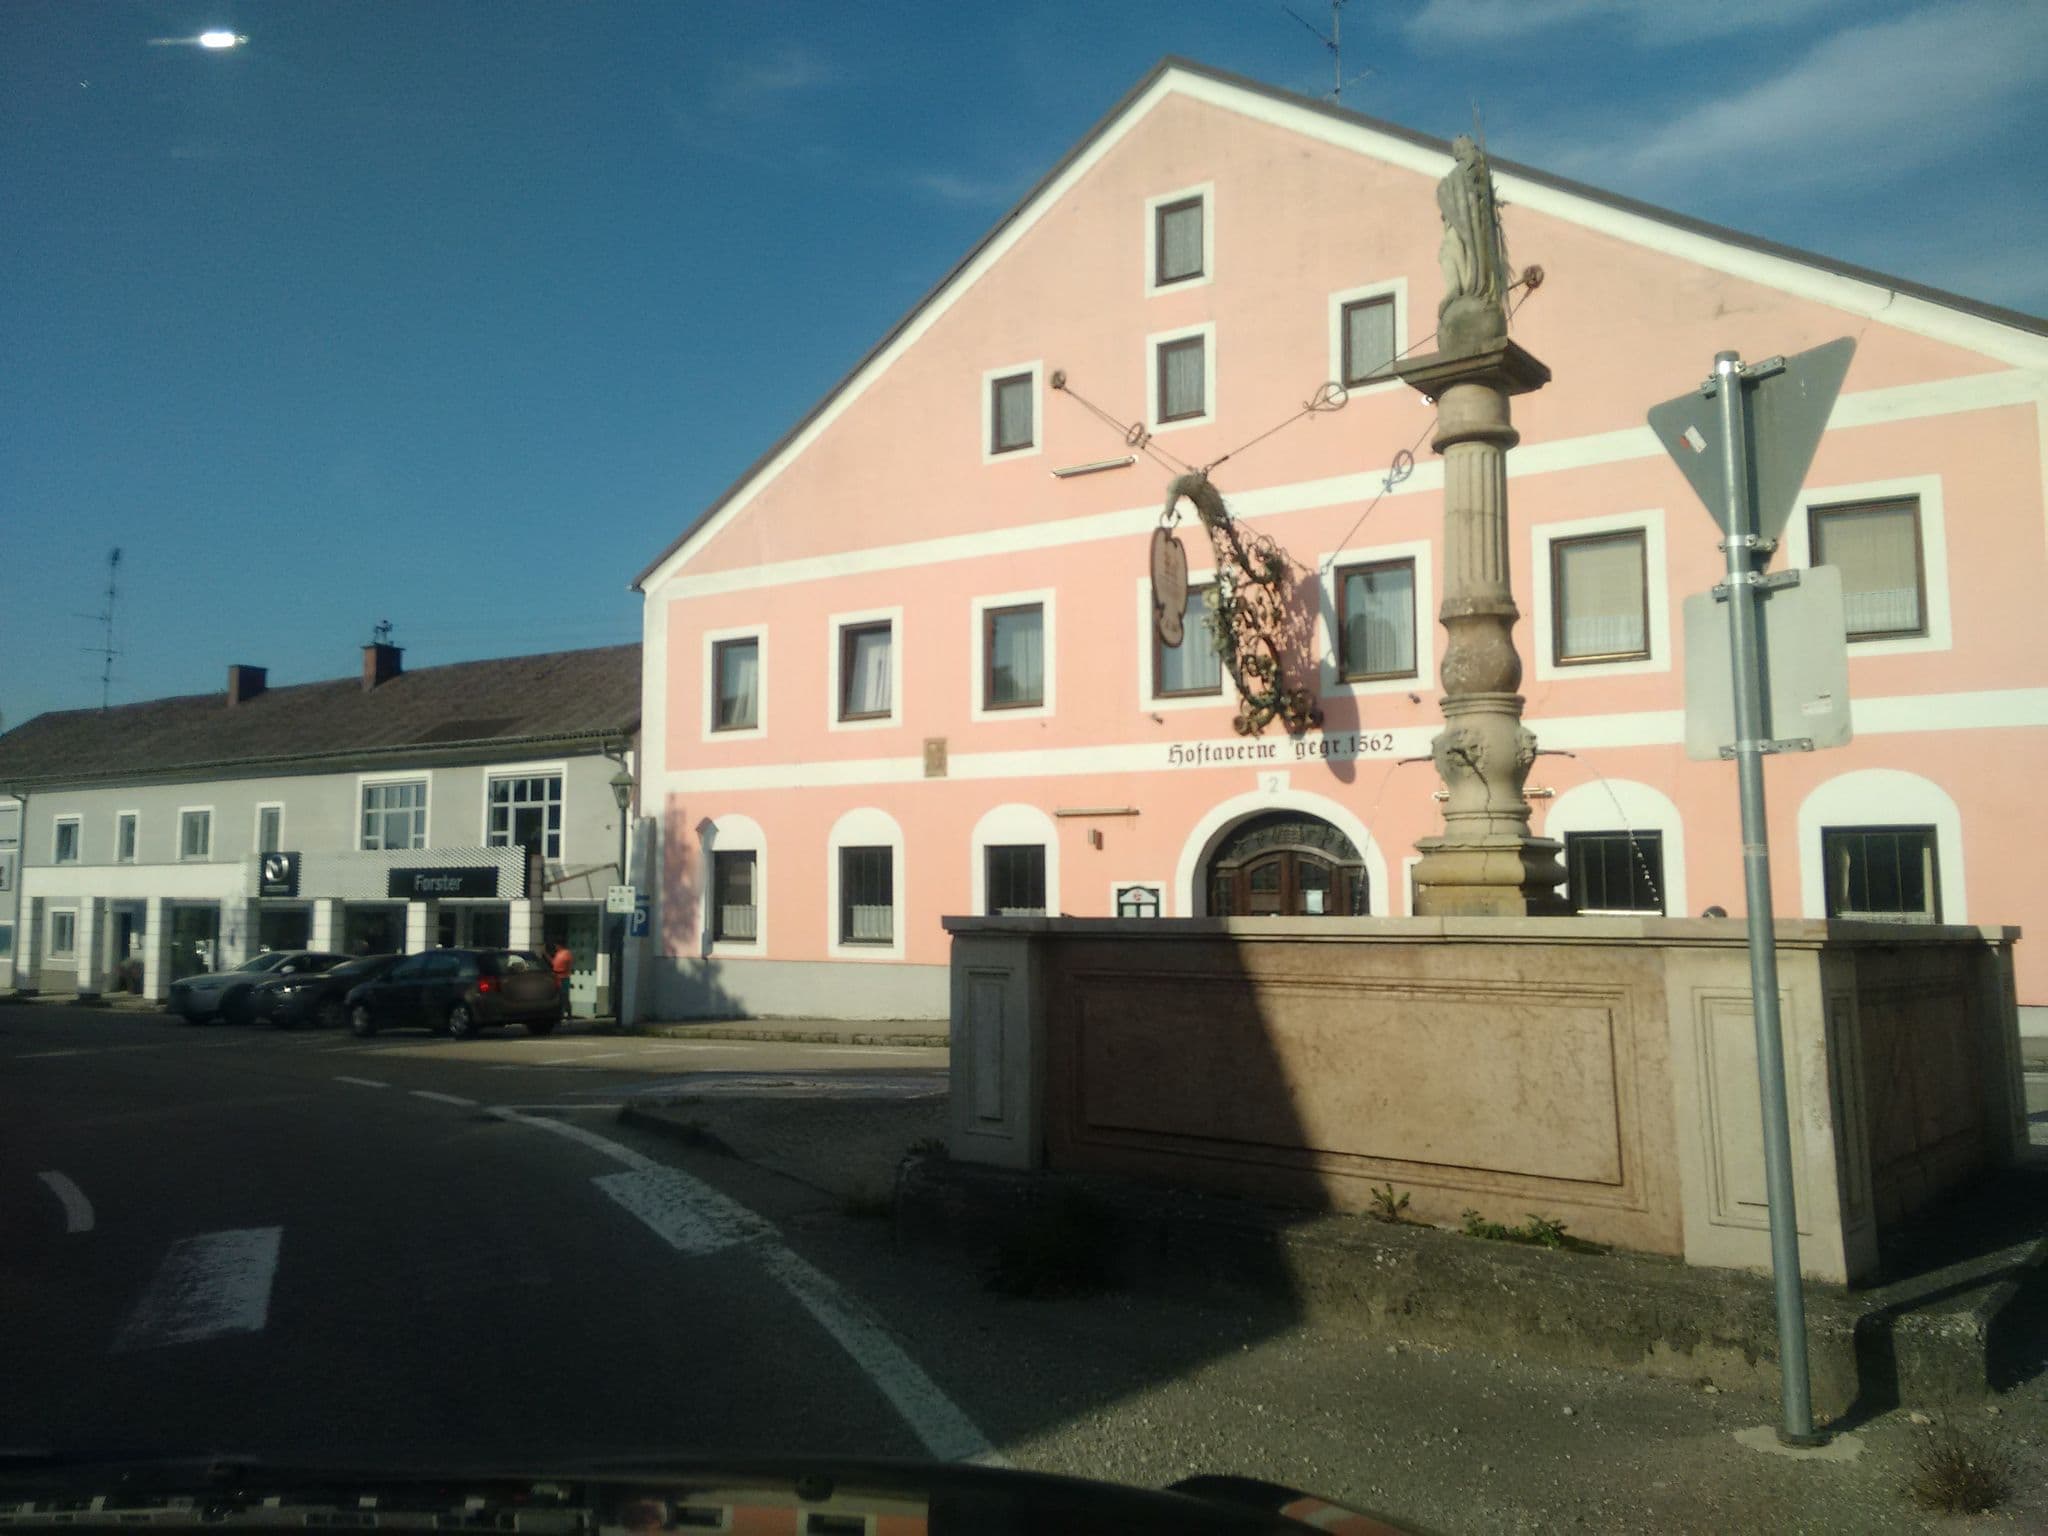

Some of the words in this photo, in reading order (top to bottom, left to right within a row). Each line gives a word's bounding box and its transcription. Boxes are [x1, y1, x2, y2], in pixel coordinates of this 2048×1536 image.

[1168, 742, 1277, 768] Hoftaverne
[1269, 776, 1279, 793] 2
[415, 874, 463, 891] Forster
[634, 909, 646, 932] P
